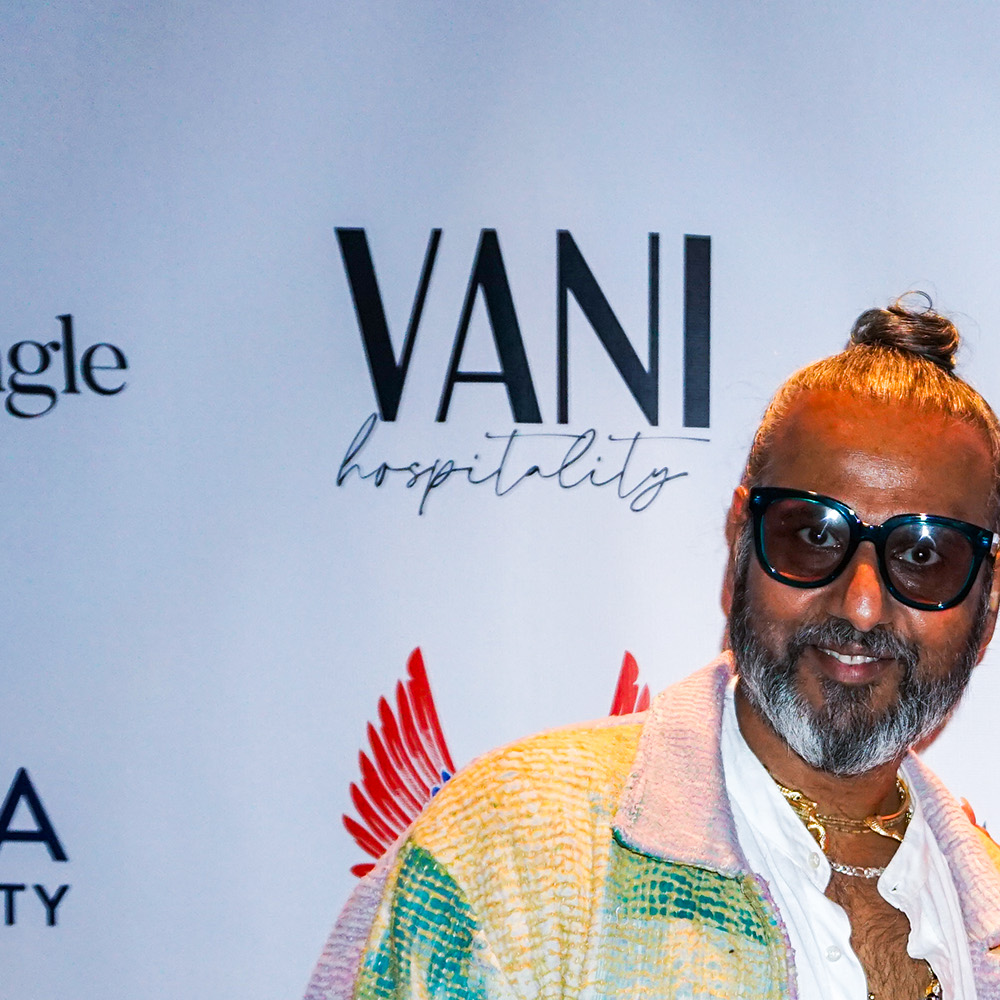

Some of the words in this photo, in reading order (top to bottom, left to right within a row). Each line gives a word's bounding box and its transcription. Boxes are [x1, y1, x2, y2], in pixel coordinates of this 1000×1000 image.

[0, 313, 129, 419] gle
[334, 226, 712, 429] VANI
[336, 413, 711, 516] hospitality
